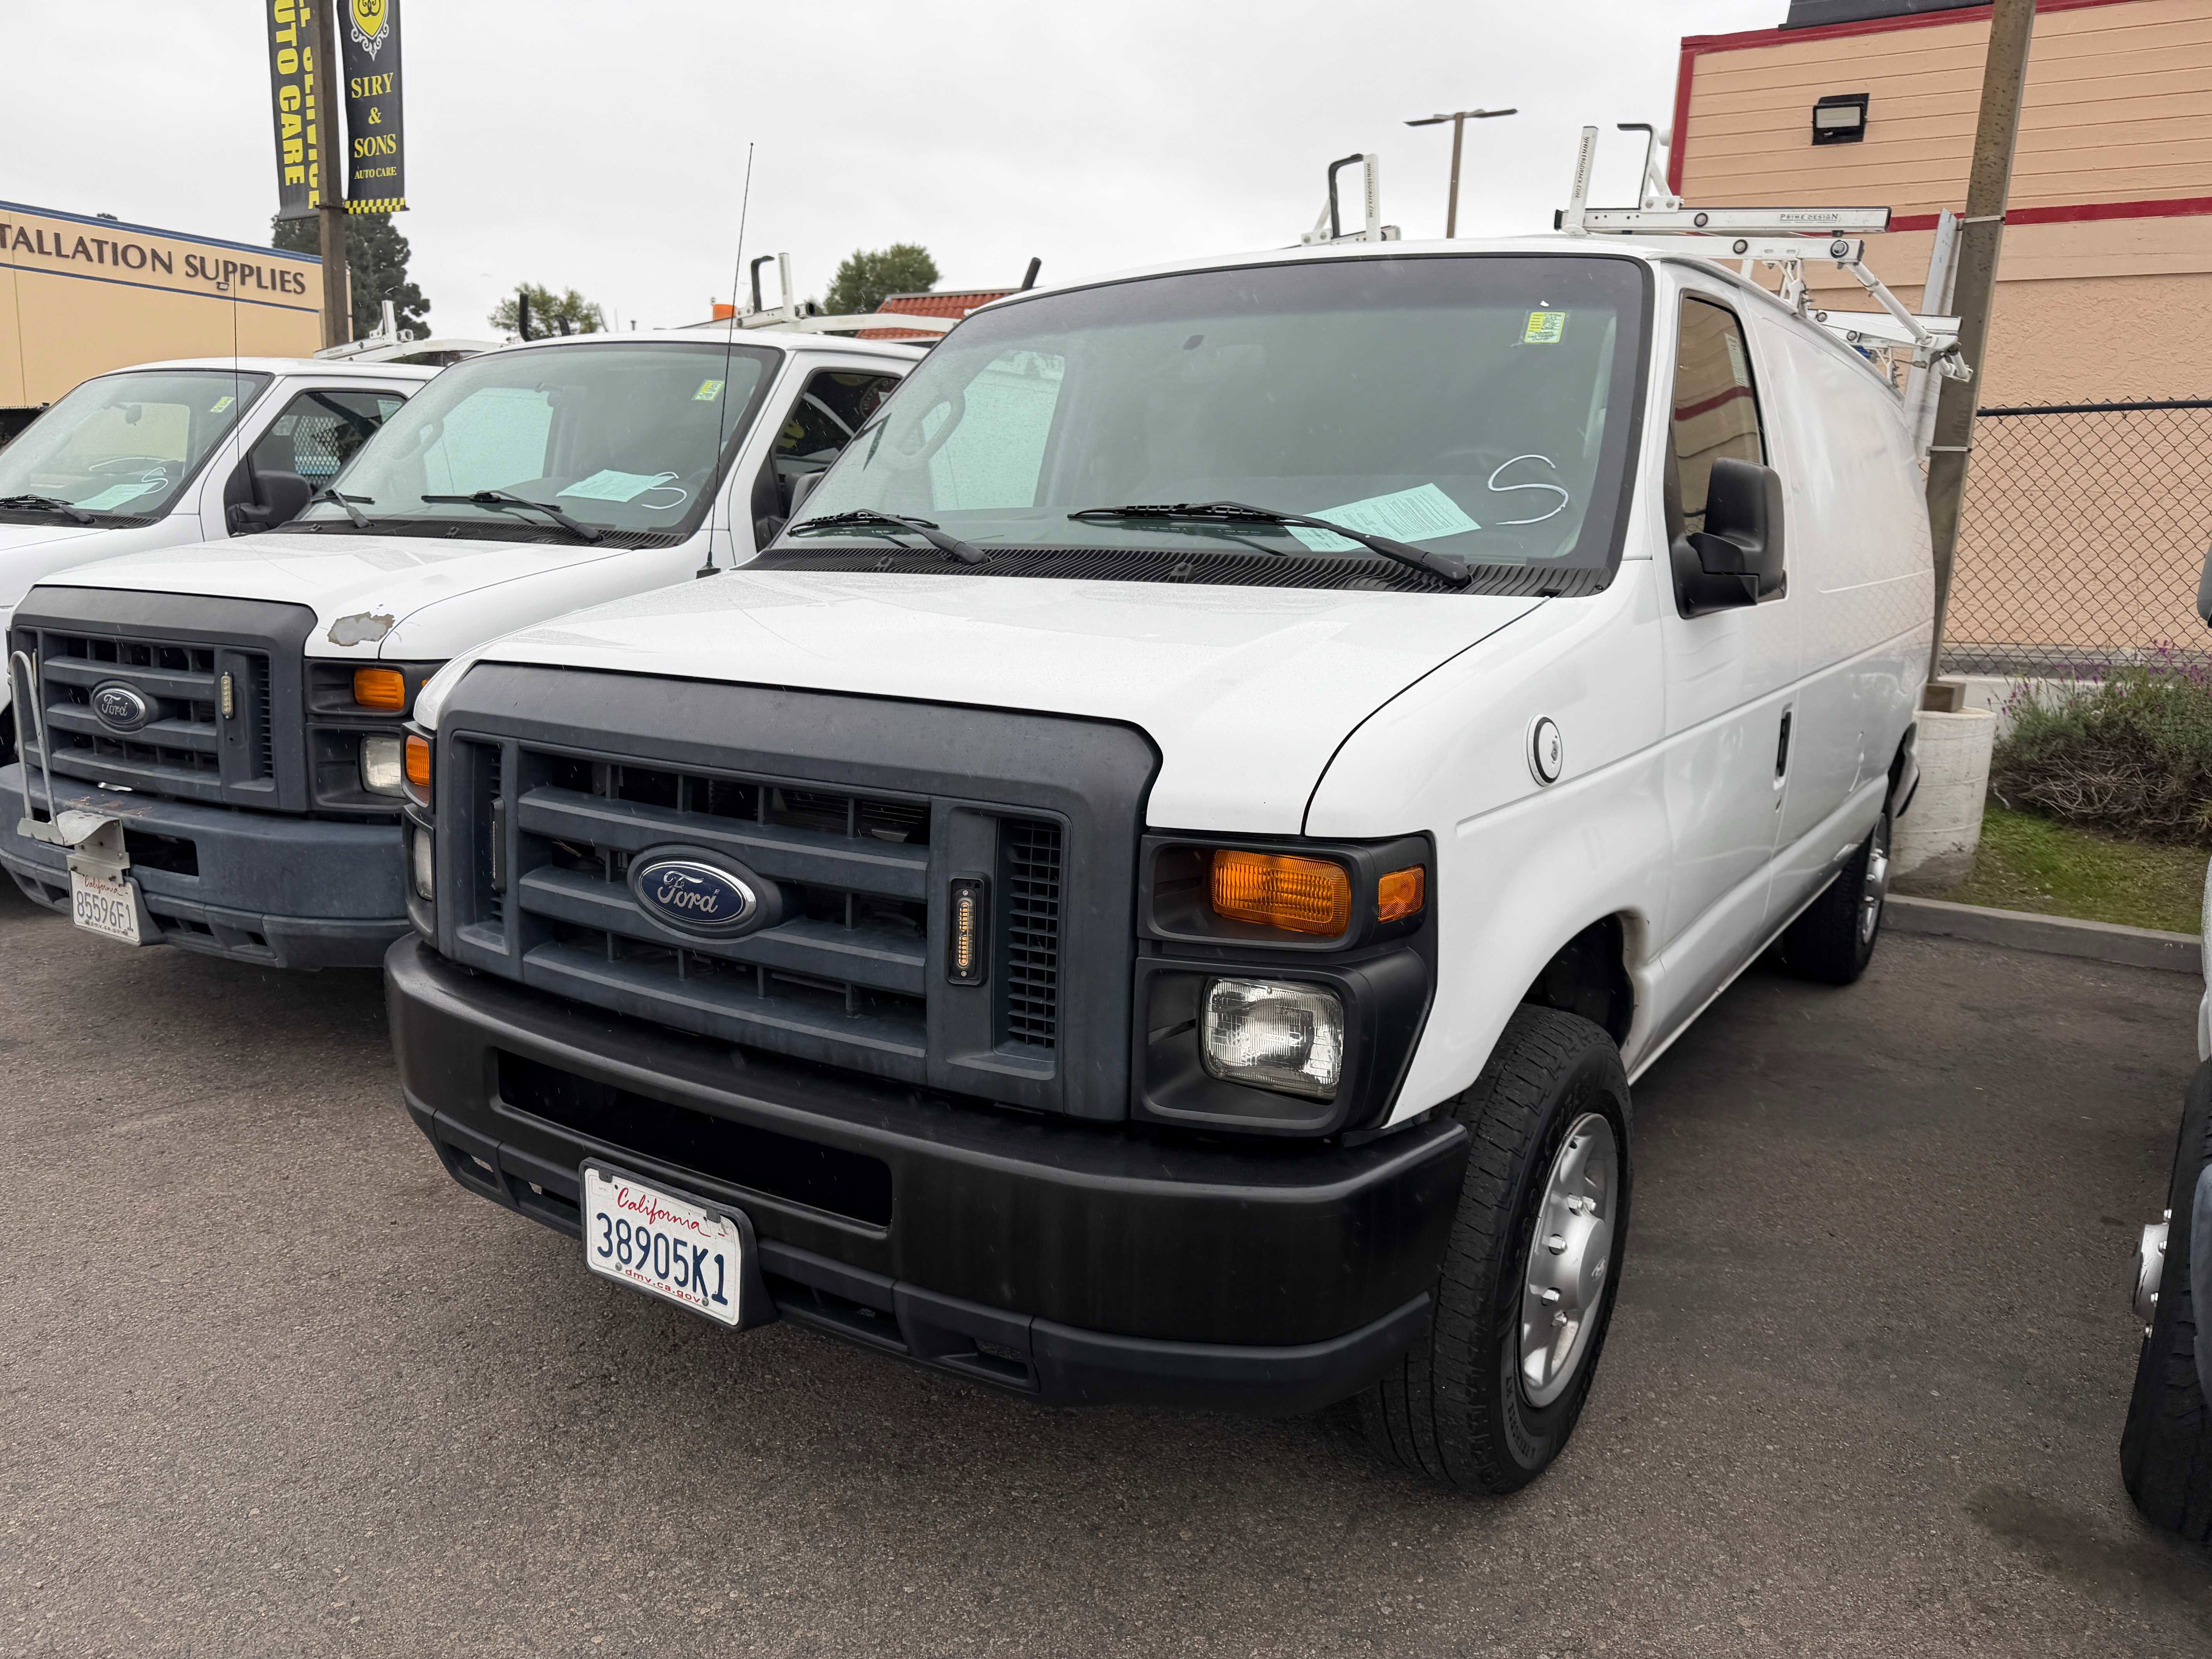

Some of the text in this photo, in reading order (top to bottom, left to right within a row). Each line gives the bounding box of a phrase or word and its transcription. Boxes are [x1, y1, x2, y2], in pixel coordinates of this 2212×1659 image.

[351, 72, 394, 99] SIRY
[368, 107, 381, 125] &
[279, 85, 305, 186] CARE
[354, 134, 397, 158] SONS
[354, 167, 397, 179] AUTO CARE
[185, 254, 306, 295] SUPPLIES
[102, 694, 127, 716] Ford
[84, 874, 124, 896] California
[658, 871, 720, 913] Ford
[77, 890, 134, 932] 85596F1
[617, 1187, 711, 1238] California
[596, 1212, 728, 1306] 38905K1
[625, 1268, 701, 1304] dmv.ca.gov
